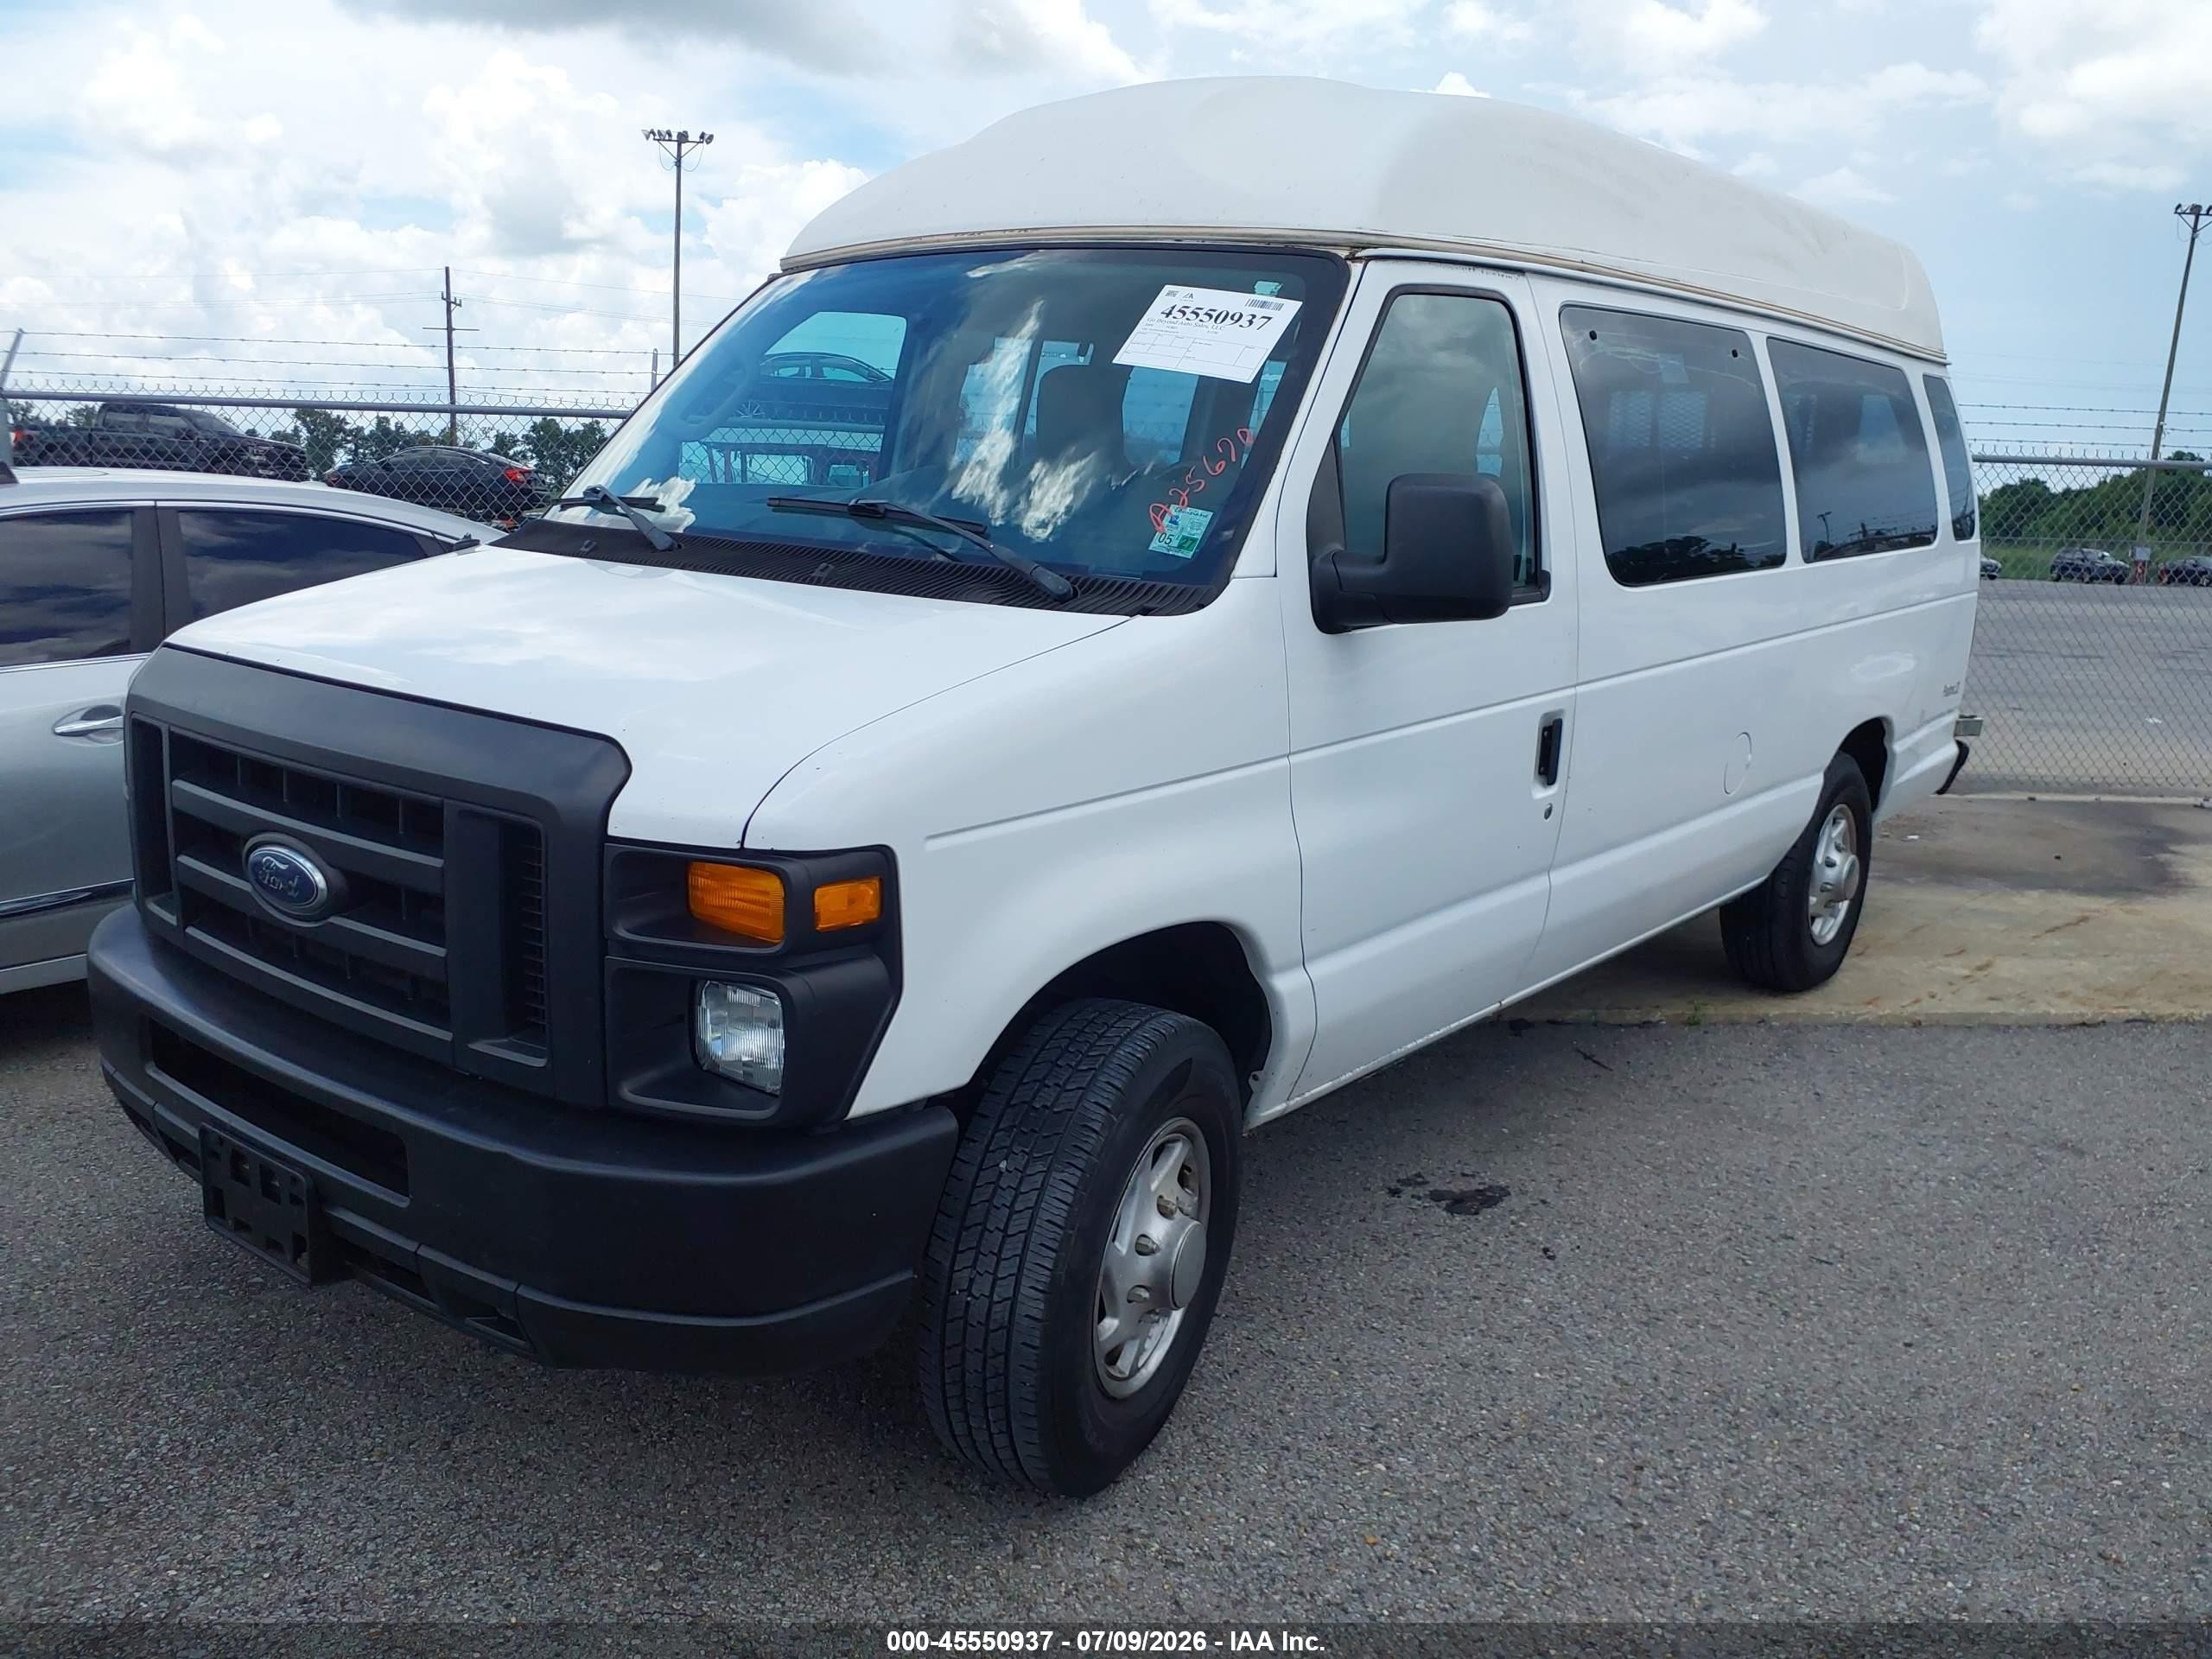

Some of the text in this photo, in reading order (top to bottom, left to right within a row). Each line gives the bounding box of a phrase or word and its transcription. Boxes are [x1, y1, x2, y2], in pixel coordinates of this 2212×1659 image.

[1160, 303, 1274, 331] 45550937
[1158, 532, 1175, 545] 05
[1180, 537, 1198, 550] 27
